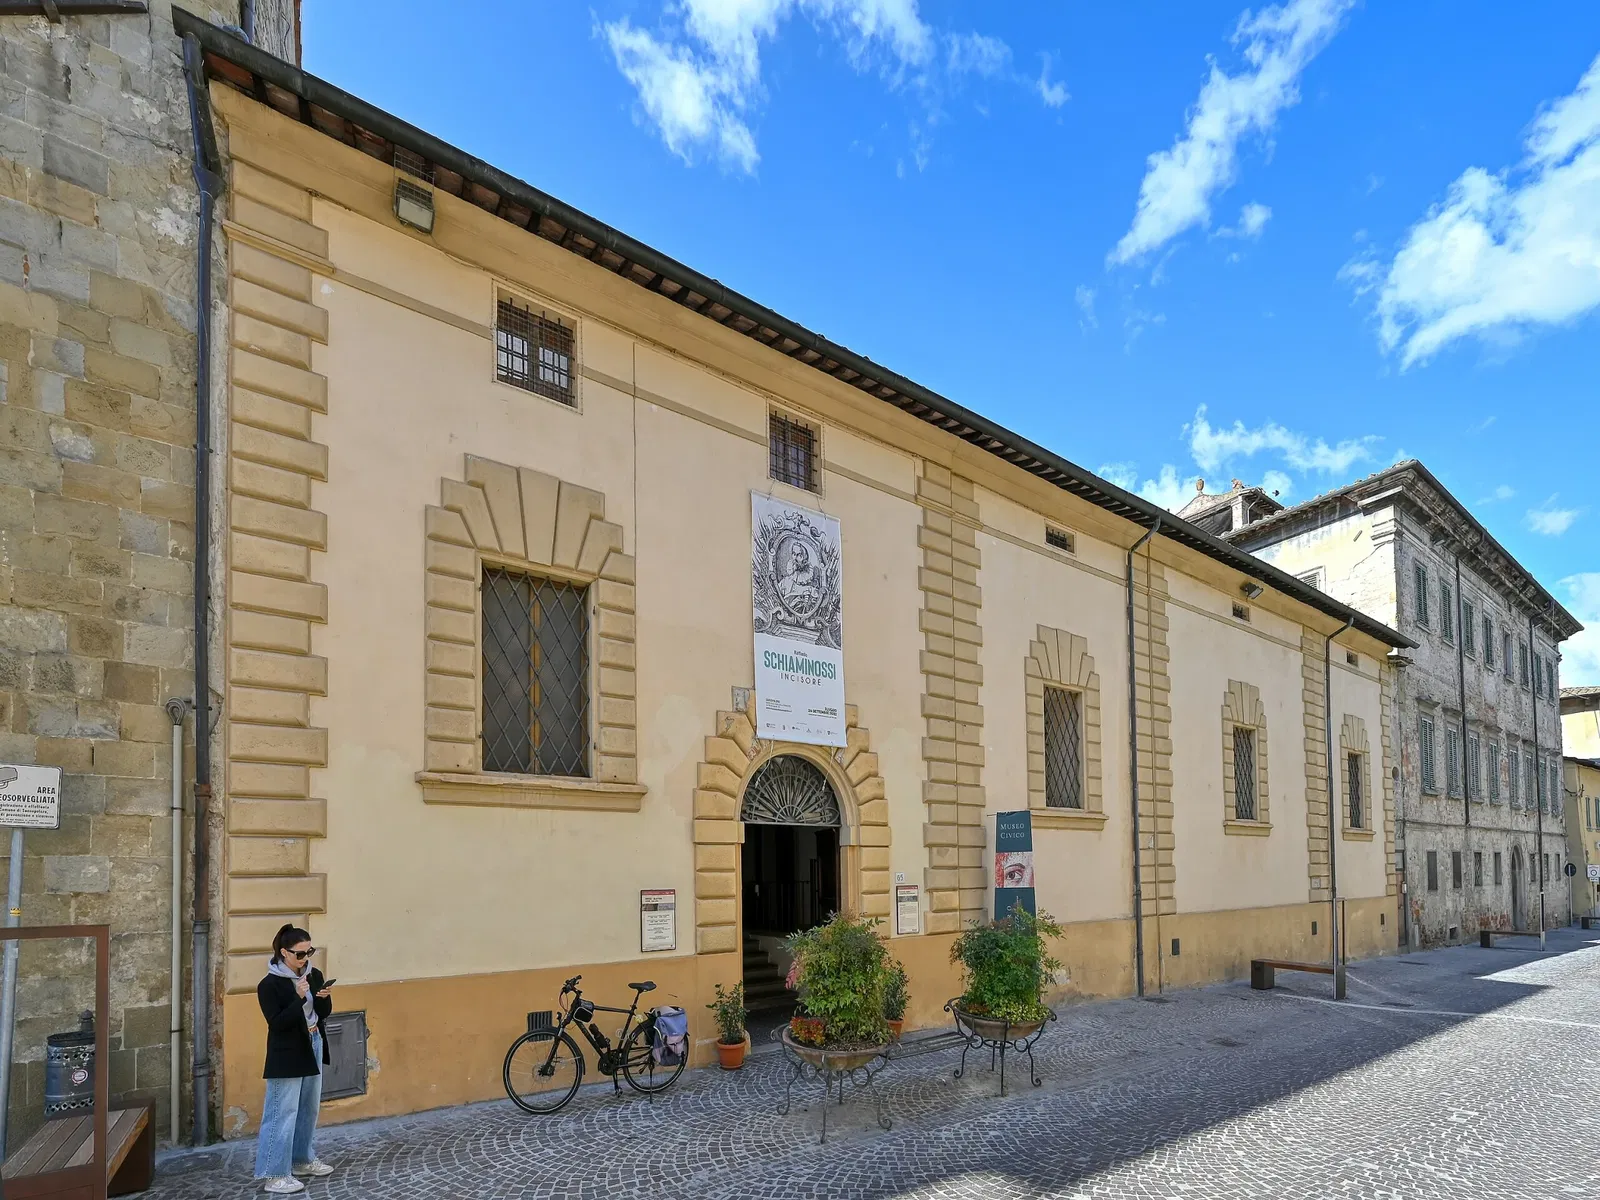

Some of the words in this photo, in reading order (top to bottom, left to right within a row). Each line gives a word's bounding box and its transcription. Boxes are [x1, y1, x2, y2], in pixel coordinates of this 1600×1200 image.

[764, 650, 836, 680] SCHIAMINOSSI
[780, 672, 822, 686] INCISORE
[37, 786, 56, 794] AREA
